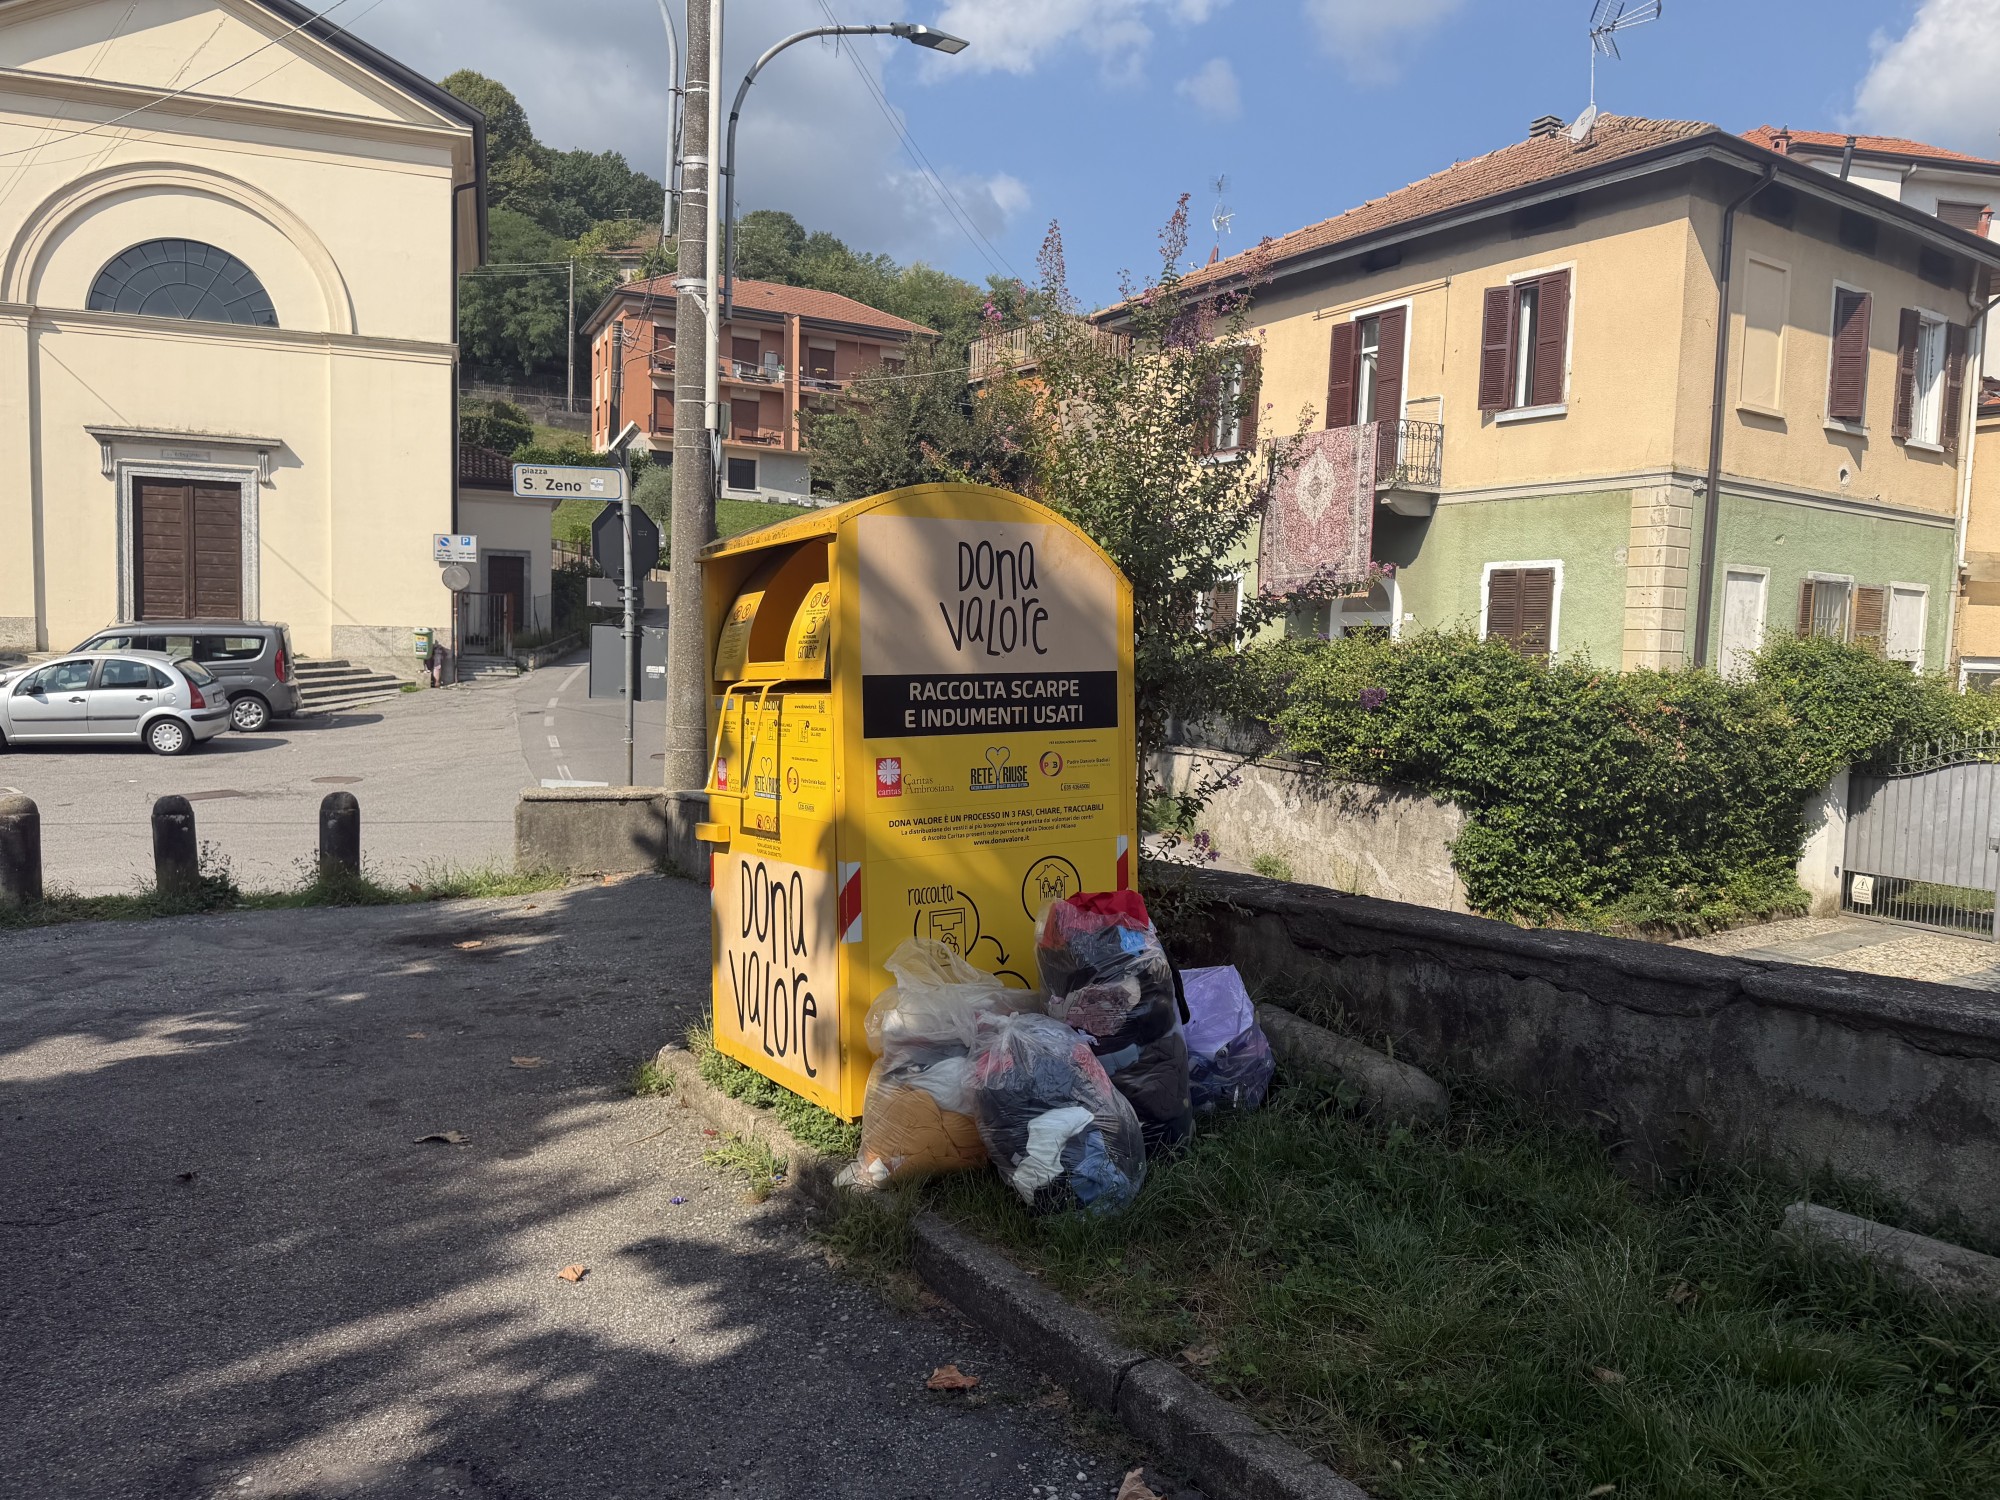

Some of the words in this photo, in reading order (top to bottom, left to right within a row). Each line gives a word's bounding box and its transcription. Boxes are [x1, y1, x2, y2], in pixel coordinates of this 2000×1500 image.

[521, 467, 548, 475] piazza
[523, 477, 538, 490] S.
[545, 478, 582, 492] Zeno
[909, 680, 1007, 701] RACCOLTA
[1011, 679, 1080, 699] SCARPE
[904, 709, 917, 728] E
[921, 706, 1028, 728] INDUMENTI
[1033, 704, 1083, 724] USATI
[903, 773, 934, 786] Caritas
[970, 767, 993, 785] RETE
[1002, 765, 1028, 783] RIUSE
[877, 786, 902, 796] caritas
[904, 783, 955, 795] Ambrosiana
[889, 820, 912, 828] DONA
[913, 816, 943, 826] VALORE
[944, 814, 949, 823] È
[950, 815, 961, 823] UN
[963, 811, 1001, 821] PROCESSO
[1011, 810, 1016, 818] 3
[1018, 809, 1034, 817] FASI,
[1035, 807, 1062, 816] CHIARE,
[1063, 803, 1104, 813] TRACCIABILI
[909, 827, 943, 835] distribuzione
[973, 835, 1030, 846] www.donavalore.it
[907, 883, 954, 907] raccolta
